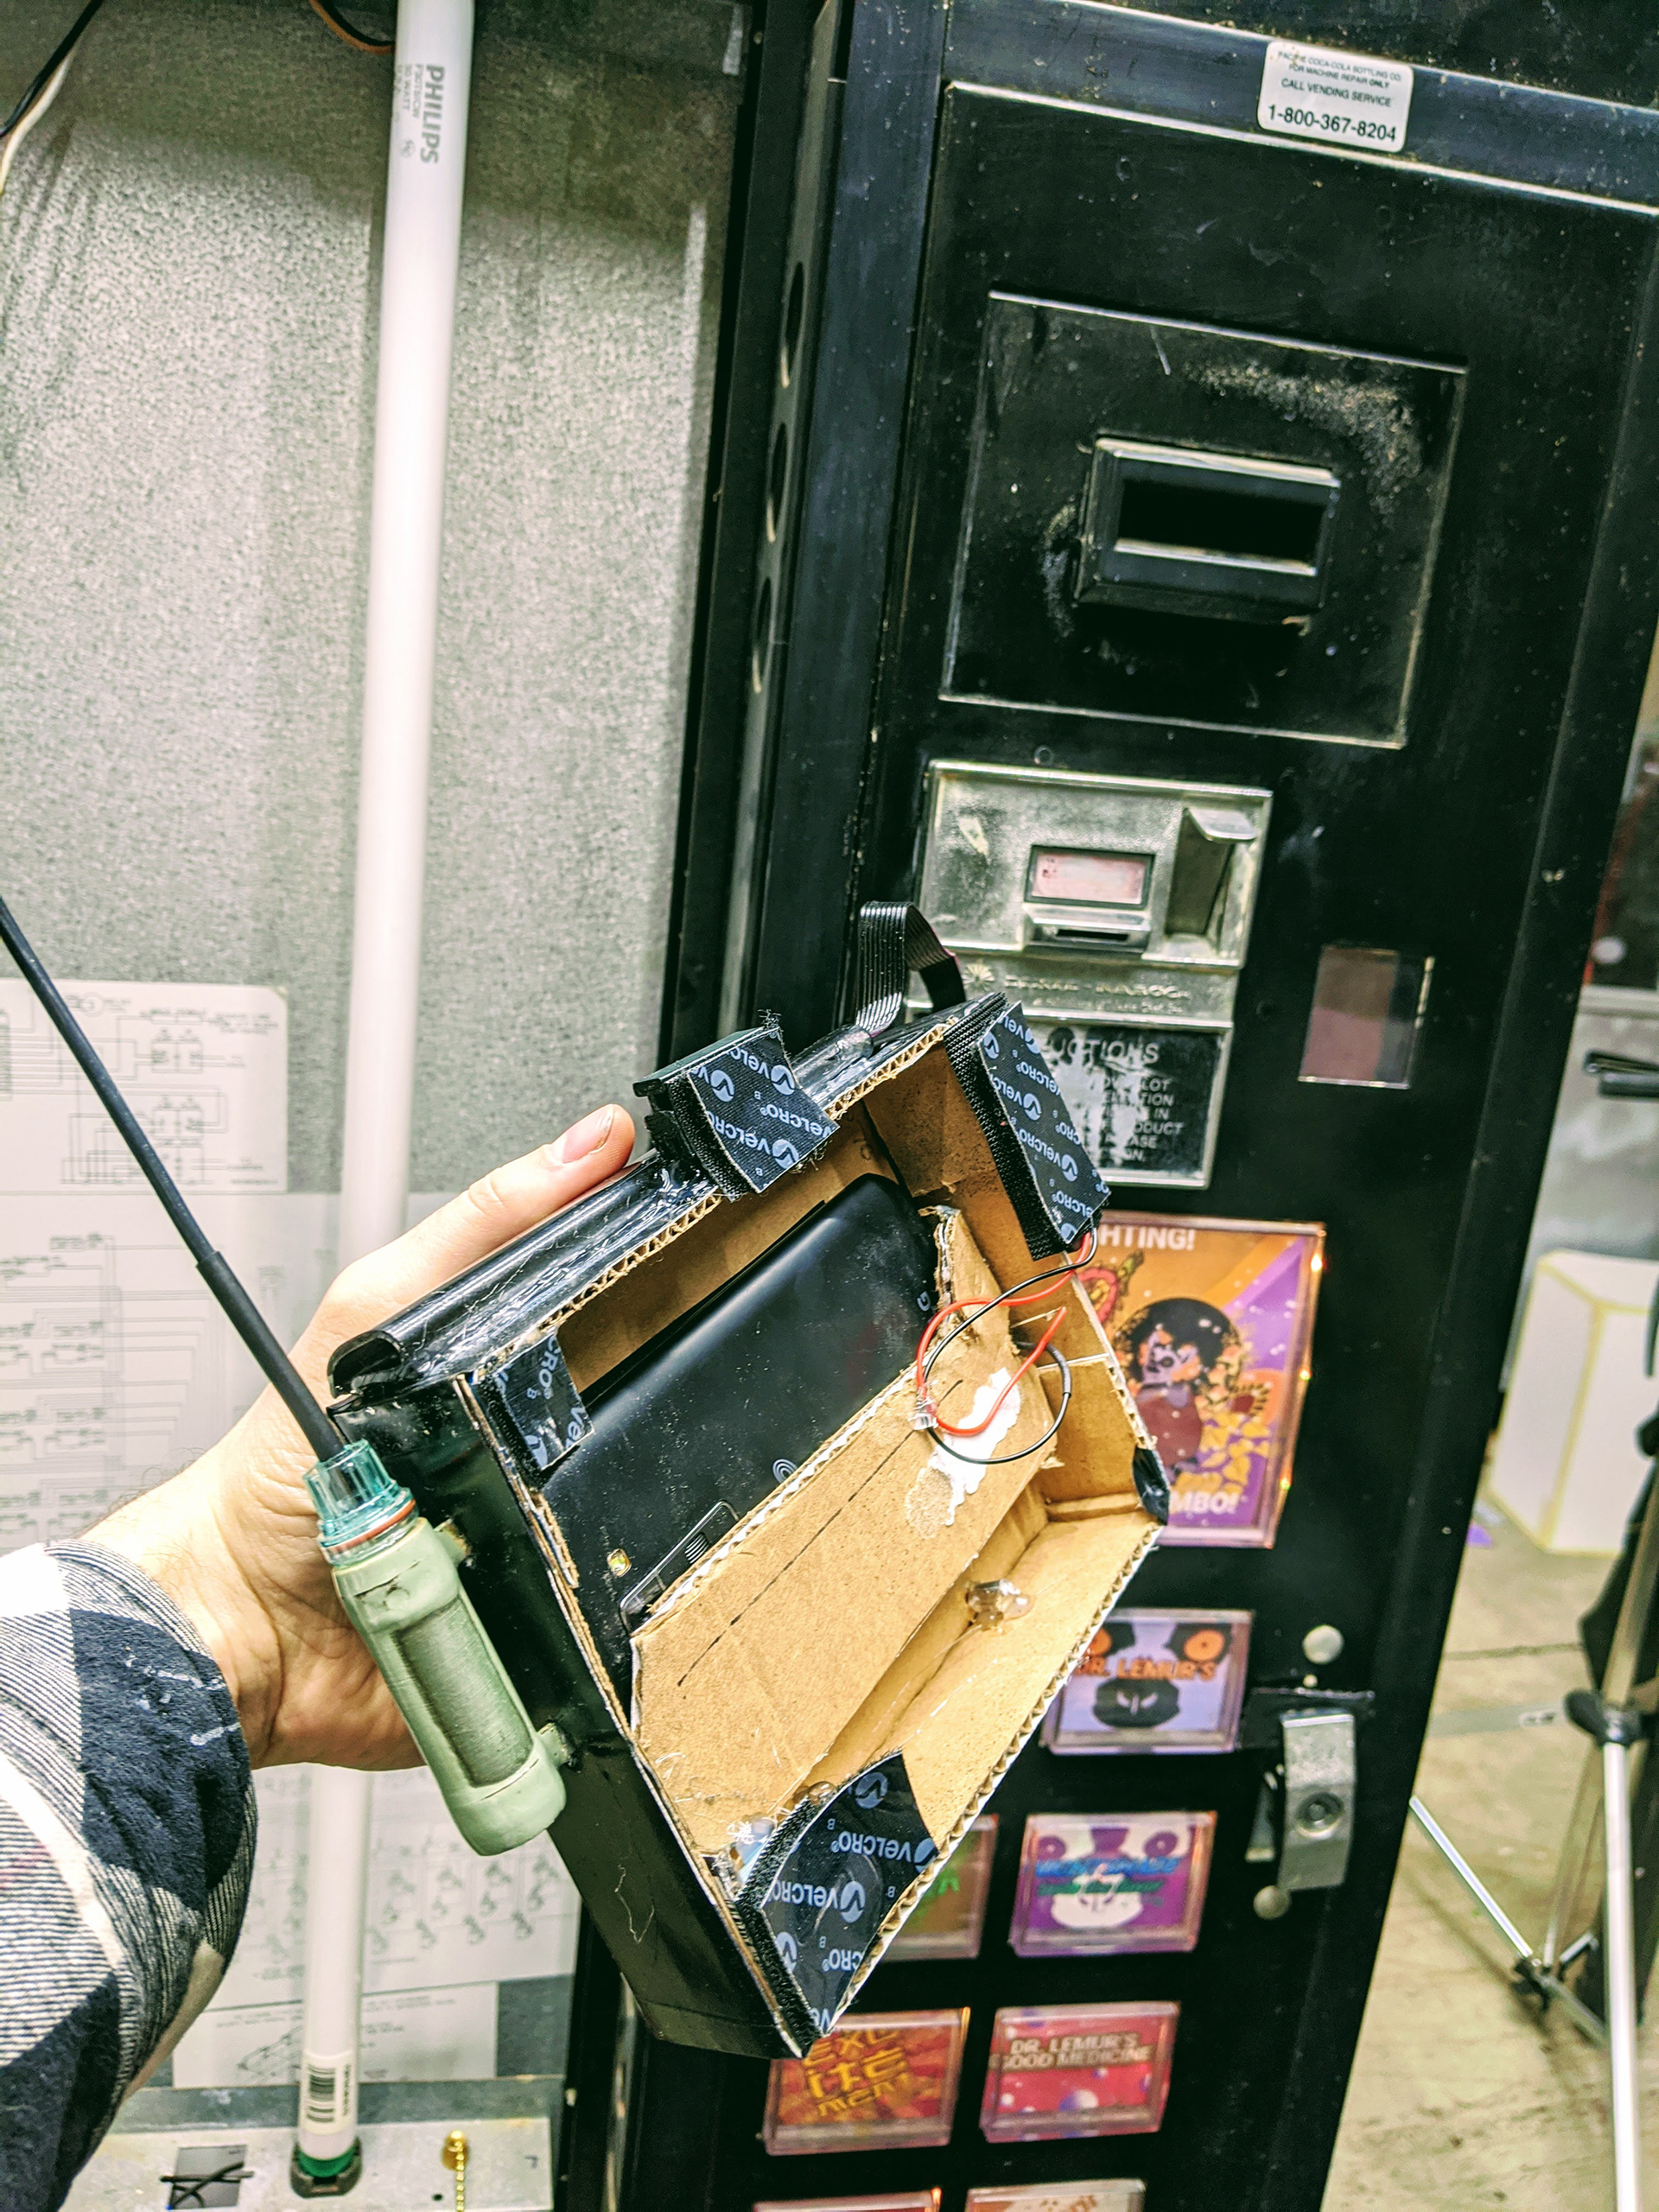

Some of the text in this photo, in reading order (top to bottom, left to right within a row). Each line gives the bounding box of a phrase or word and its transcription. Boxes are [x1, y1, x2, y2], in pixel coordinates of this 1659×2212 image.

[1288, 63, 1389, 89] FOR MACHINE REPAIR ONLY
[1308, 57, 1351, 72] COCA-COLA
[1352, 66, 1388, 79] BOTTLING
[1281, 78, 1392, 107] CALL VENDING SERVICE
[420, 64, 446, 163] PHILIPS
[1268, 105, 1396, 142] 1-800-367-8204
